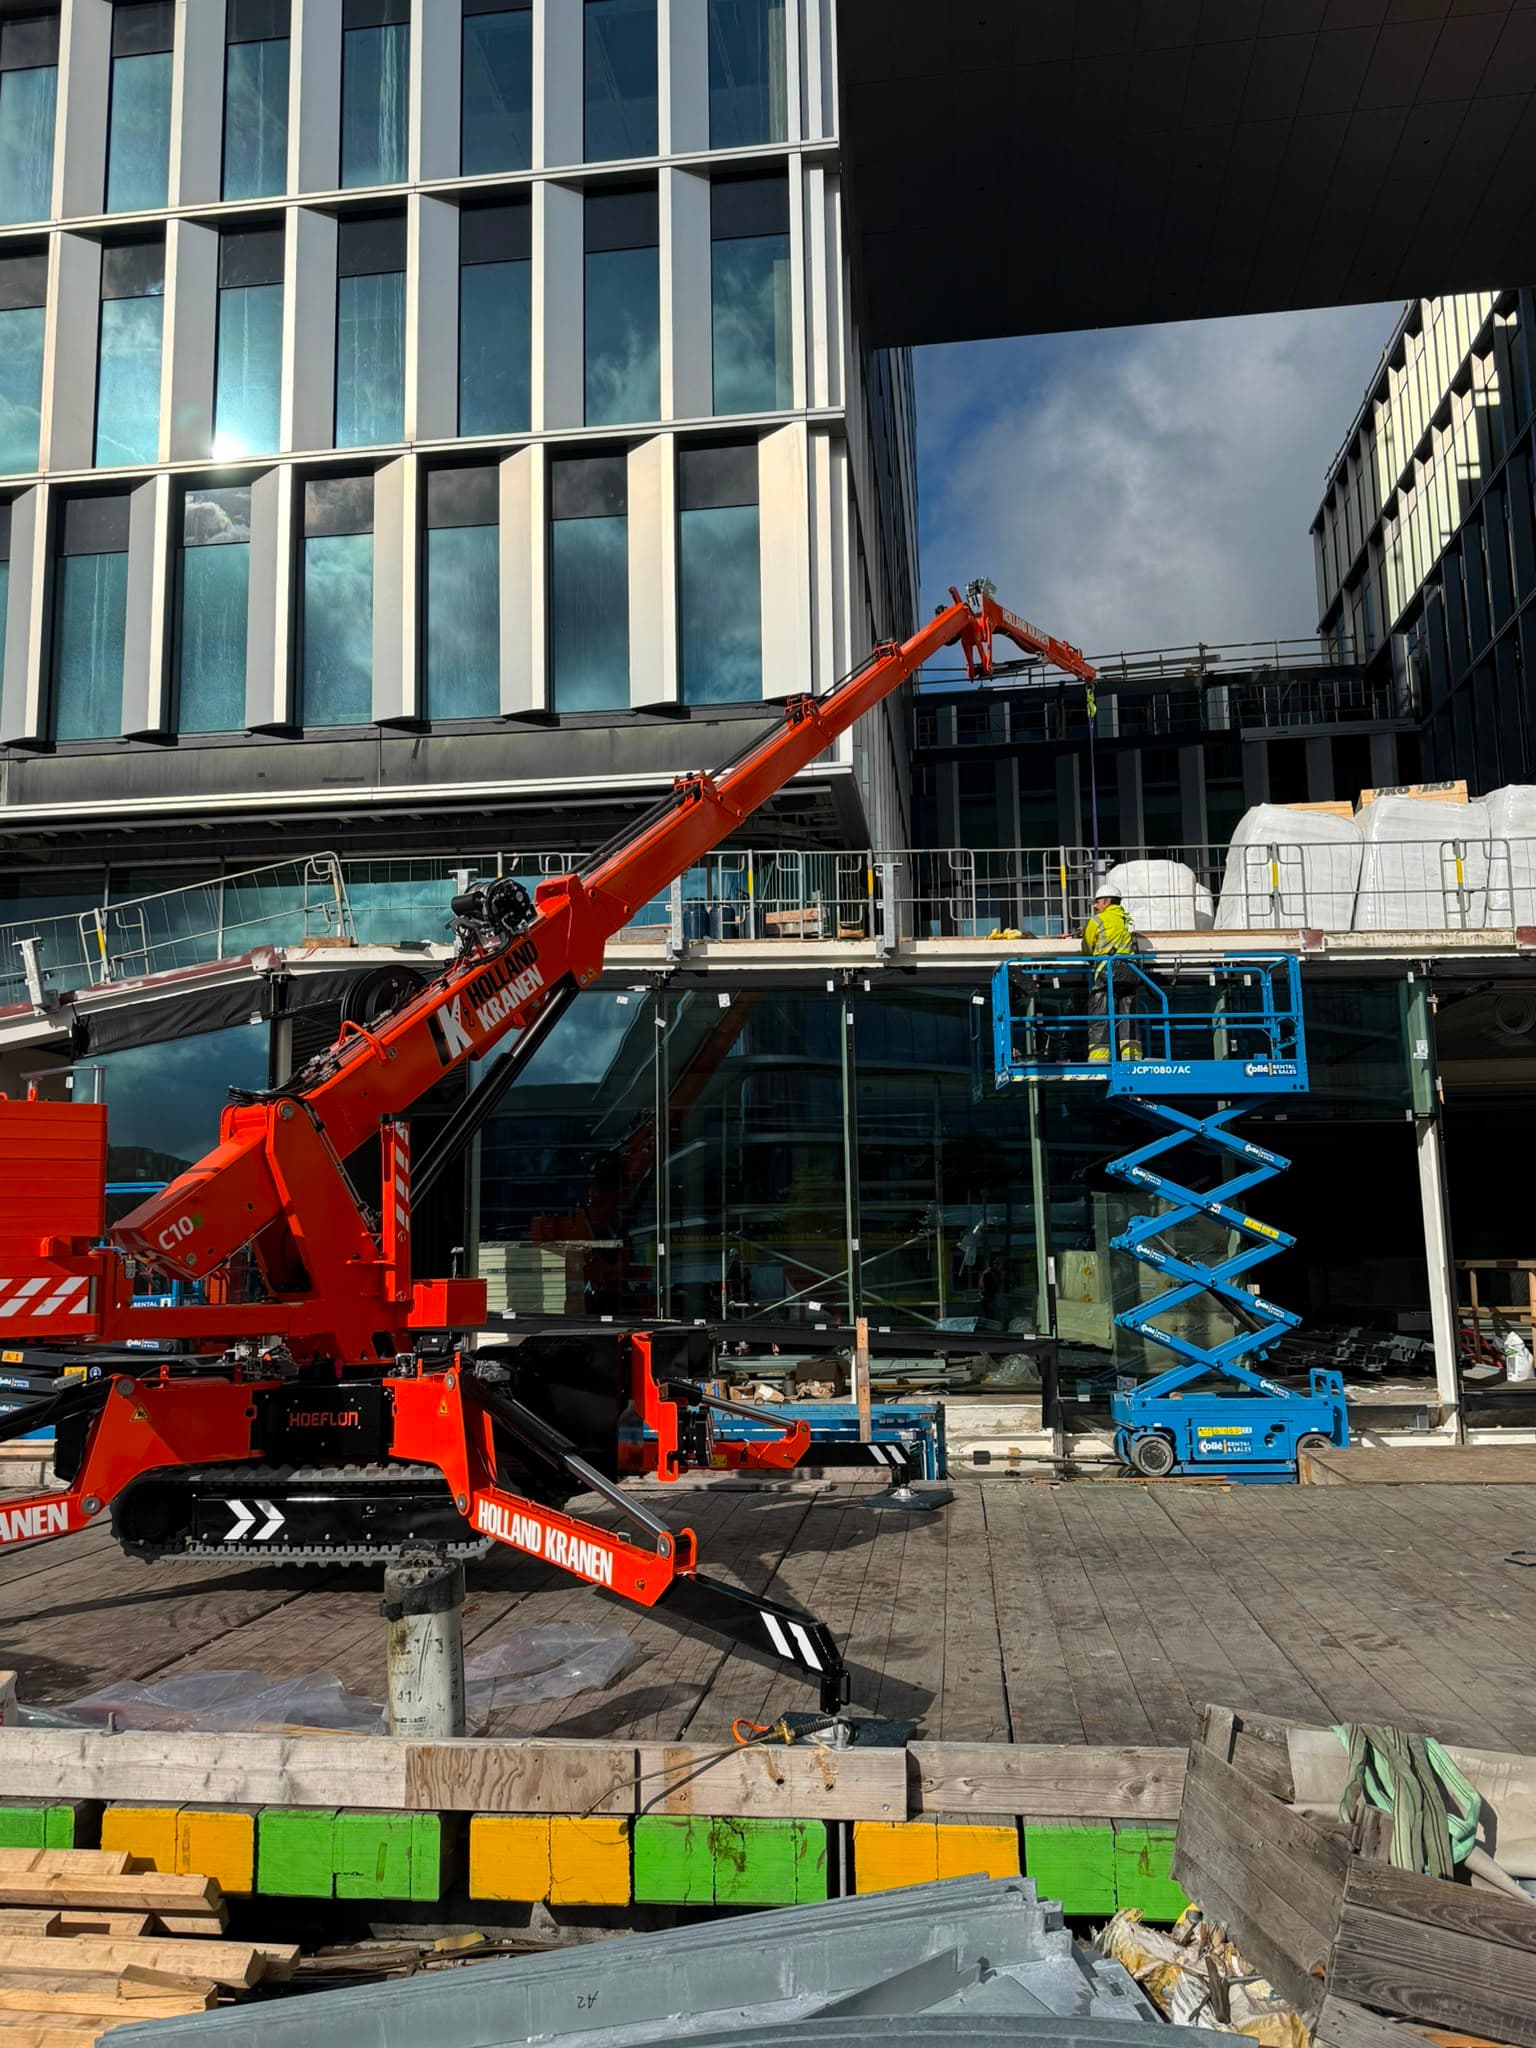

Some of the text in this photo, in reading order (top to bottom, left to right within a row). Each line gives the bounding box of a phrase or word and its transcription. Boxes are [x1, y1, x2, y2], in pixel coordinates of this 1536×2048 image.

[464, 940, 538, 1009] HOLLAND
[476, 963, 545, 1033] KRANEN
[478, 1499, 613, 1586] HOLLAND KRANEN
